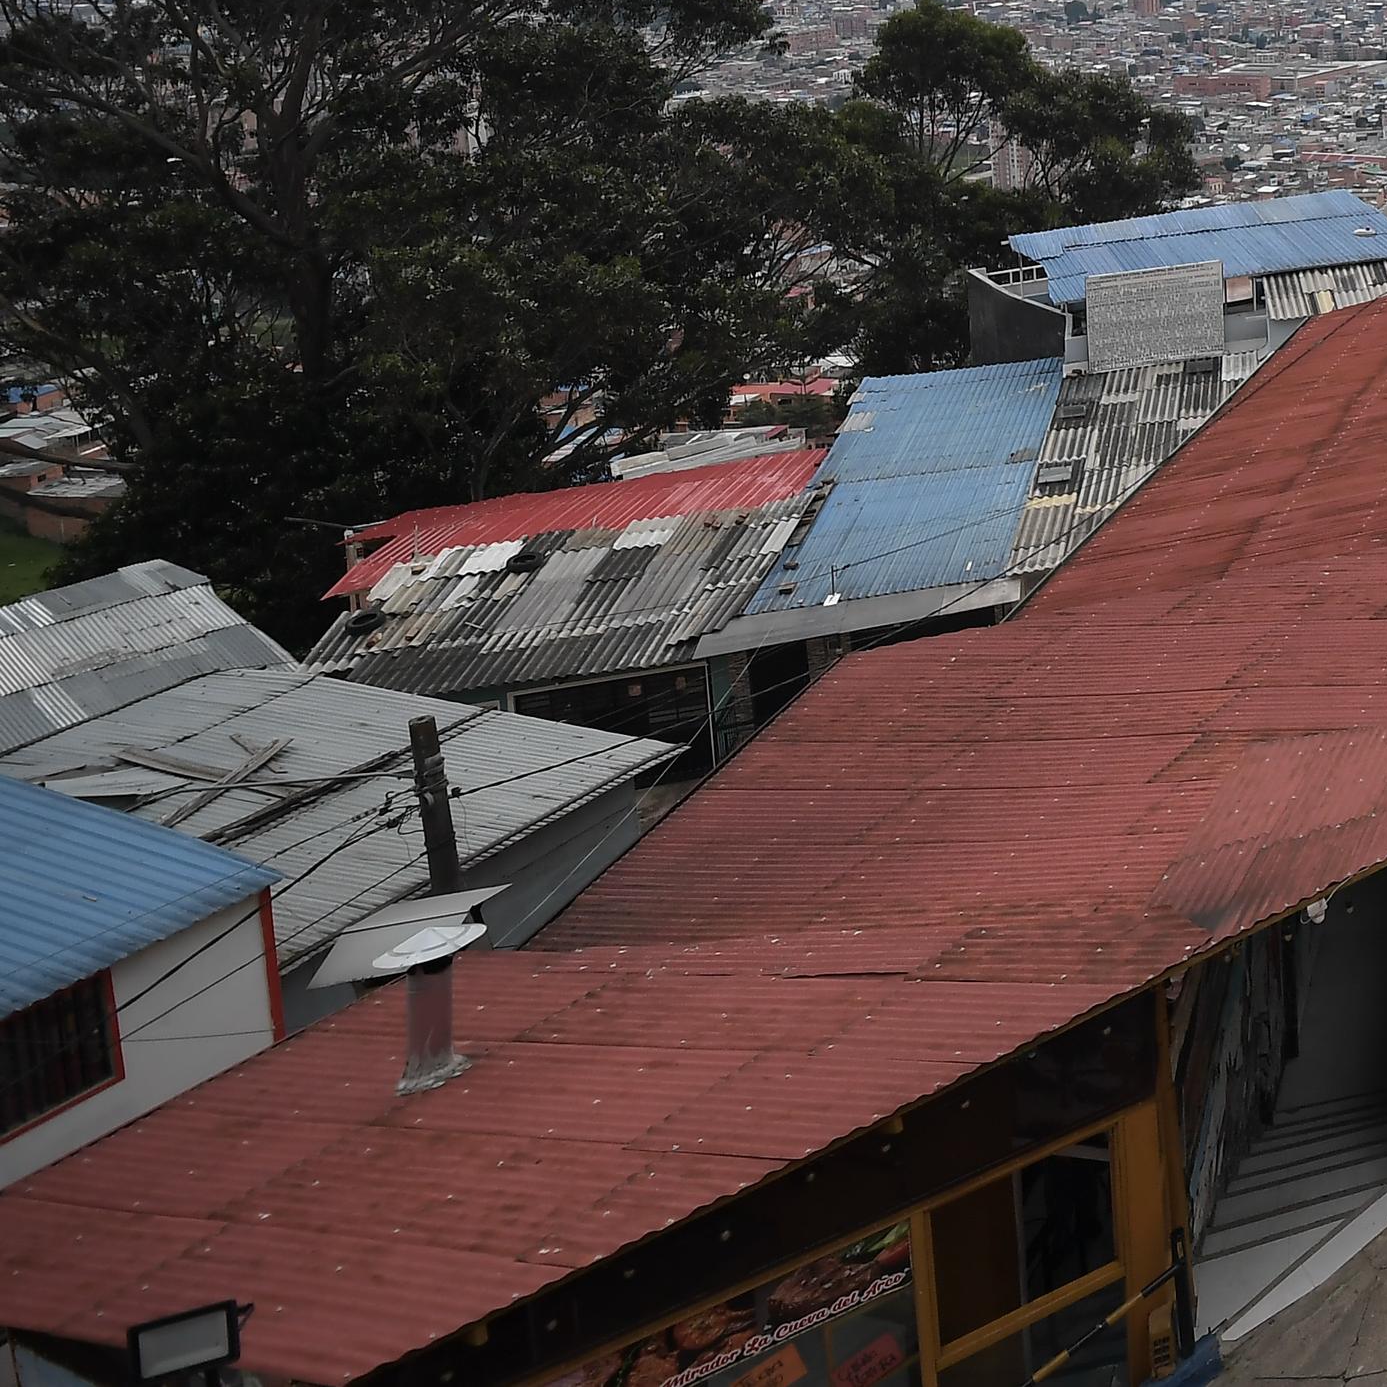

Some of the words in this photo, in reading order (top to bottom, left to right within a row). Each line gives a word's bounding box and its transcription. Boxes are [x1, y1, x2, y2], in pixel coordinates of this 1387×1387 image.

[744, 1335, 772, 1355] La
[775, 1309, 828, 1340] Cueva
[831, 1291, 859, 1312] del
[862, 1273, 905, 1301] Arco
